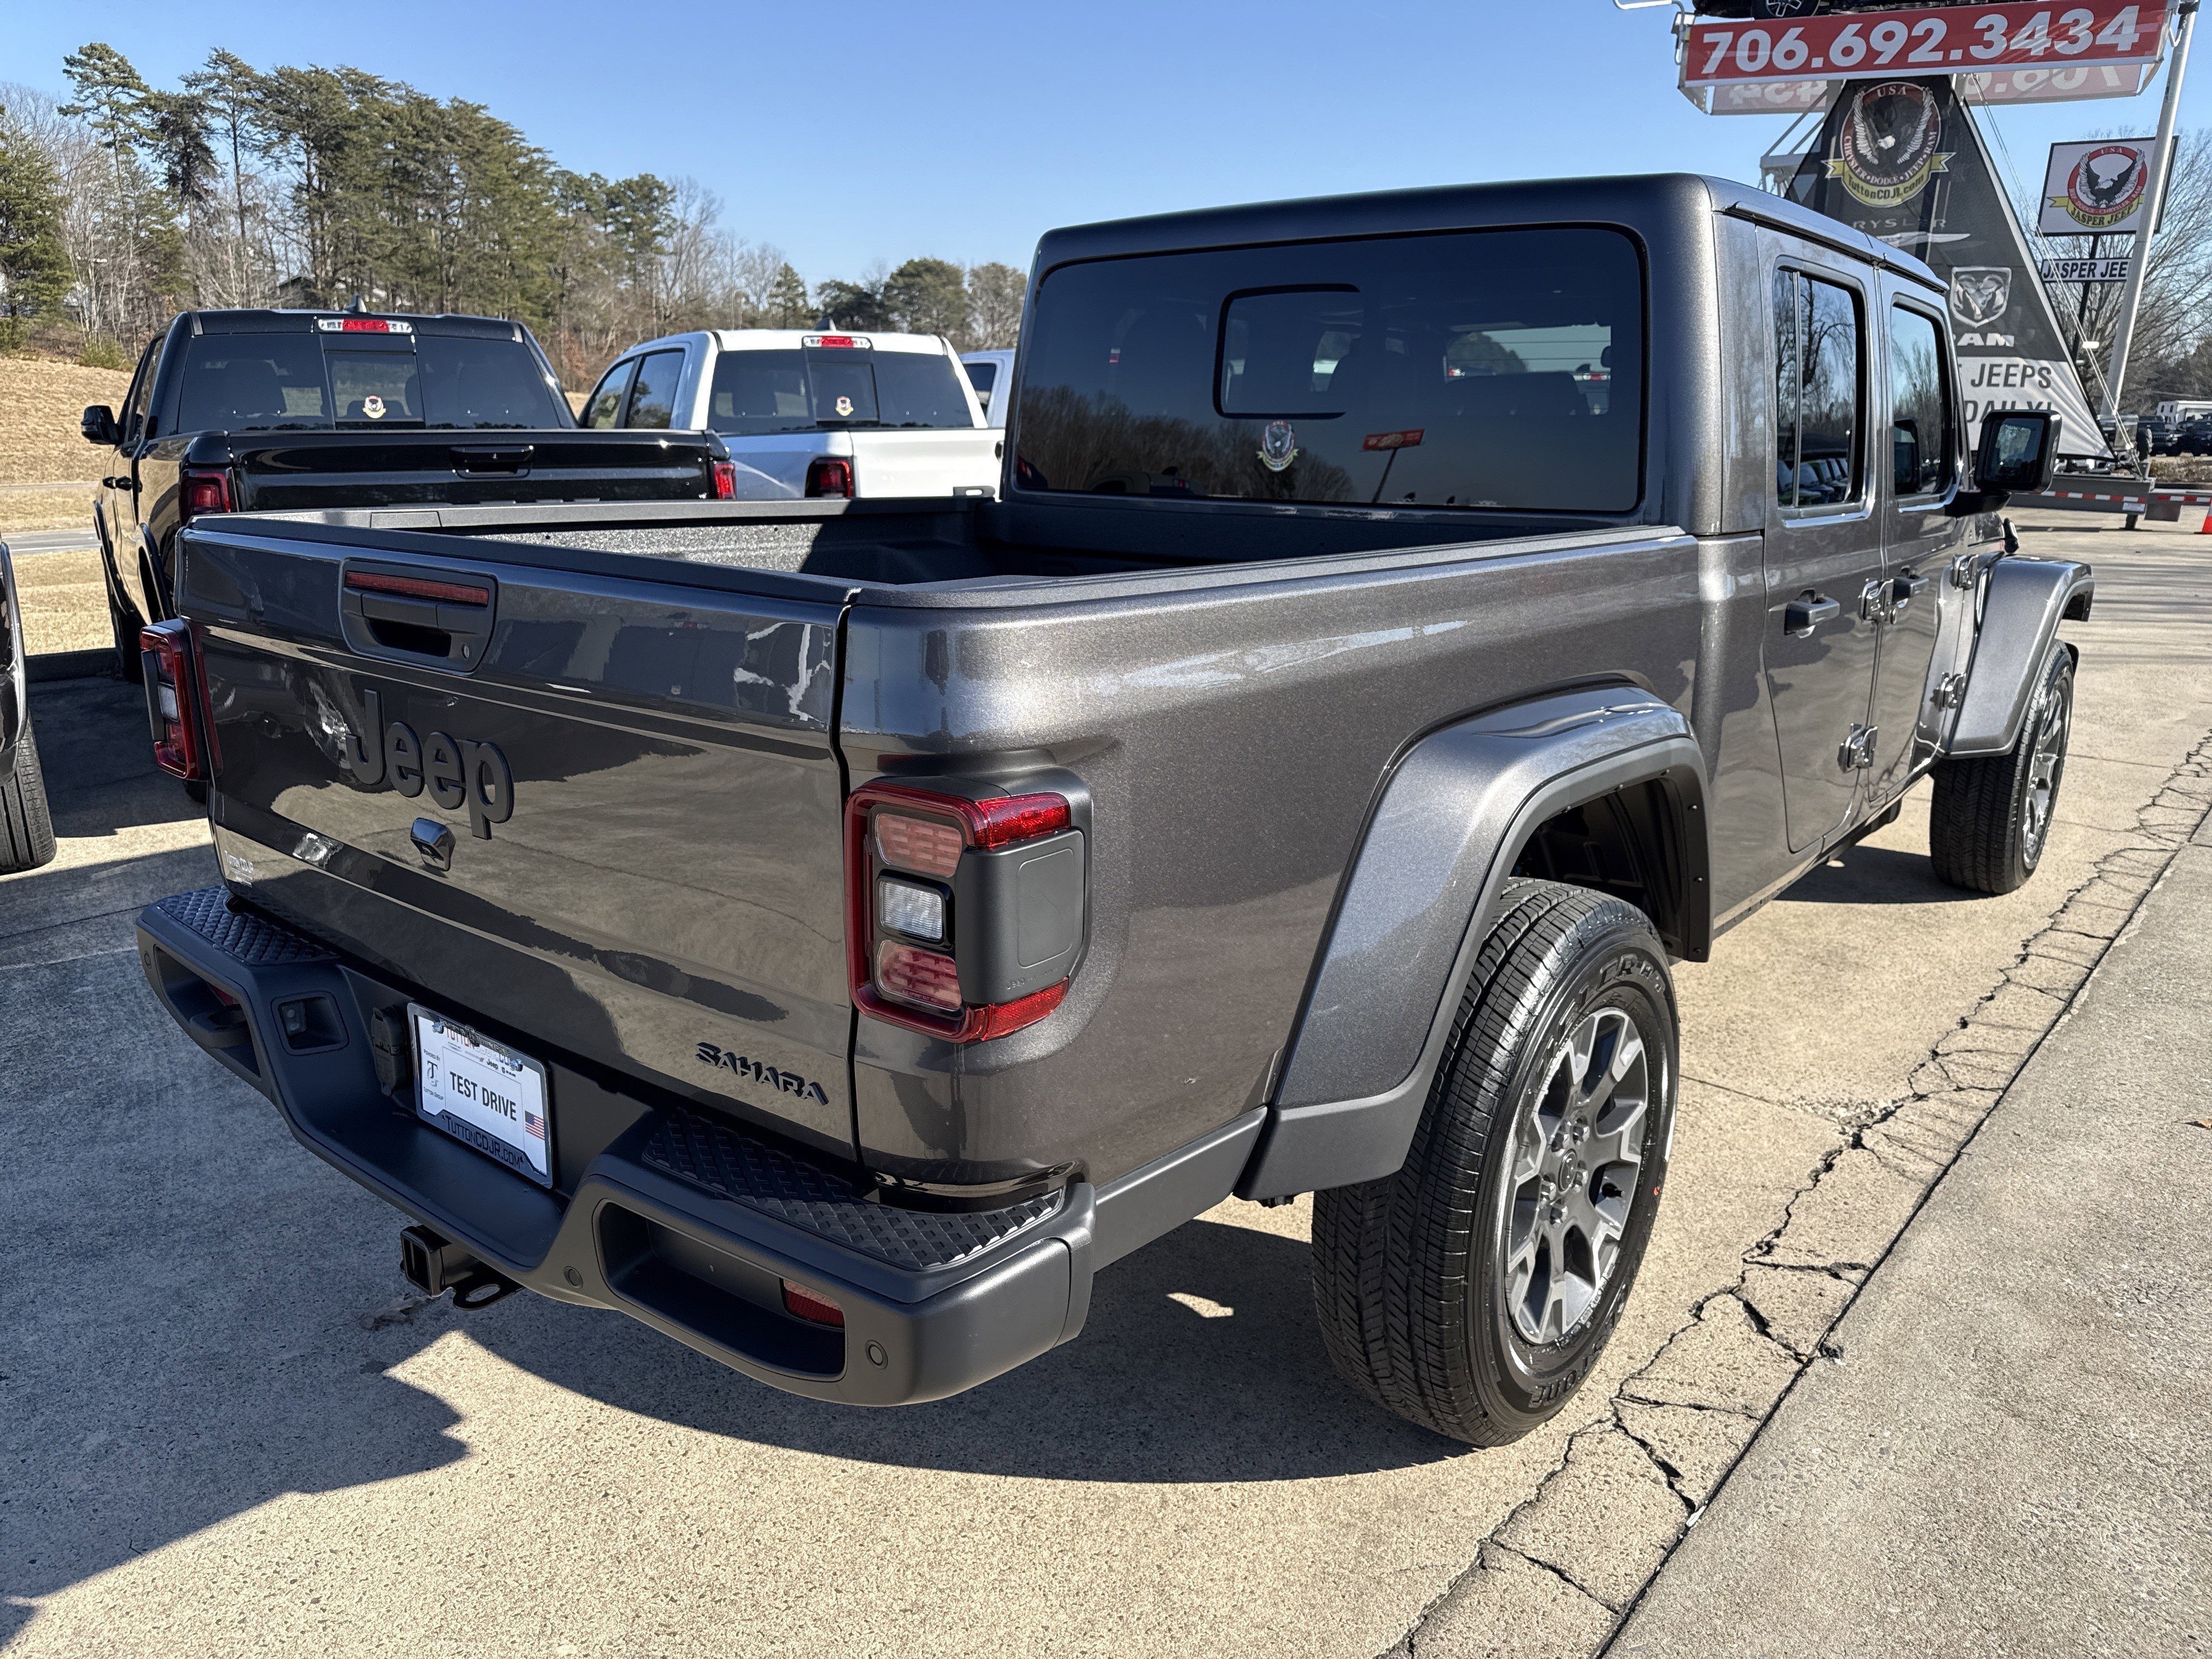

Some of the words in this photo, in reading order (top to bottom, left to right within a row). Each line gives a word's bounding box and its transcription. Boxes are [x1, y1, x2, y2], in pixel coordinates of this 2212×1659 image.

[1702, 5, 2140, 74] 706.692.3434
[1877, 86, 1906, 97] USA
[1843, 136, 1868, 180] CHRYSLER
[1870, 175, 1899, 185] DODGE
[1903, 157, 1924, 180] JEEP
[1923, 132, 1937, 154] RAM
[2071, 207, 2105, 226] JASPER
[2107, 204, 2134, 224] JEEP
[2044, 262, 2097, 279] JASPER
[2101, 261, 2128, 278] JEE
[1953, 332, 2015, 348] AM
[1971, 364, 2052, 388] JEEPS
[346, 689, 515, 840] Jeep
[486, 1058, 498, 1070] Jeep
[695, 1042, 829, 1105] SAHARA
[450, 1071, 477, 1101] TEST
[482, 1087, 517, 1121] DRIVE
